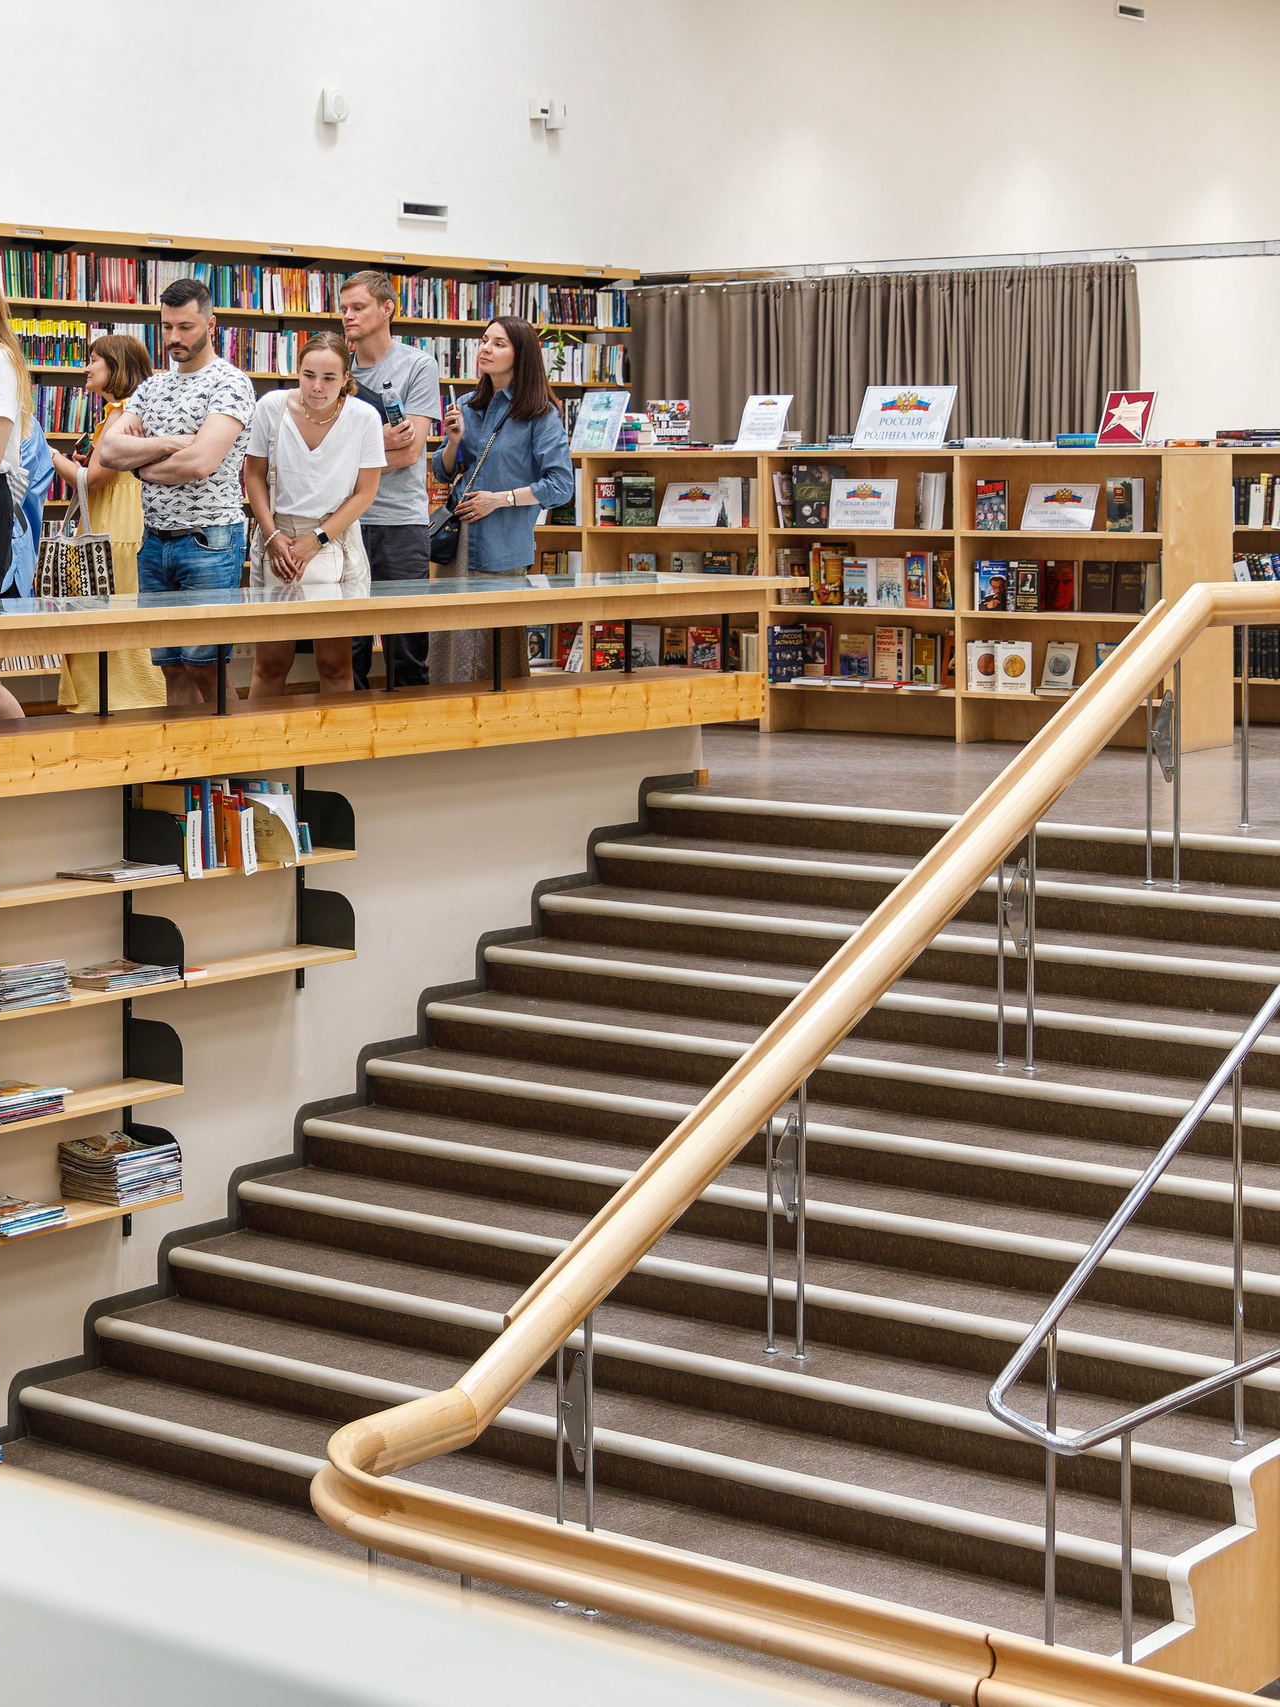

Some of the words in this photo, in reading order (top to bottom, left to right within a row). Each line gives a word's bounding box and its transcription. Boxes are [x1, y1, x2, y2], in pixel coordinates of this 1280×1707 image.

[878, 417, 923, 426] РОССИЯ
[863, 431, 907, 441] РОДИНА
[909, 431, 939, 441] МОЯ!
[835, 500, 860, 508] Русская
